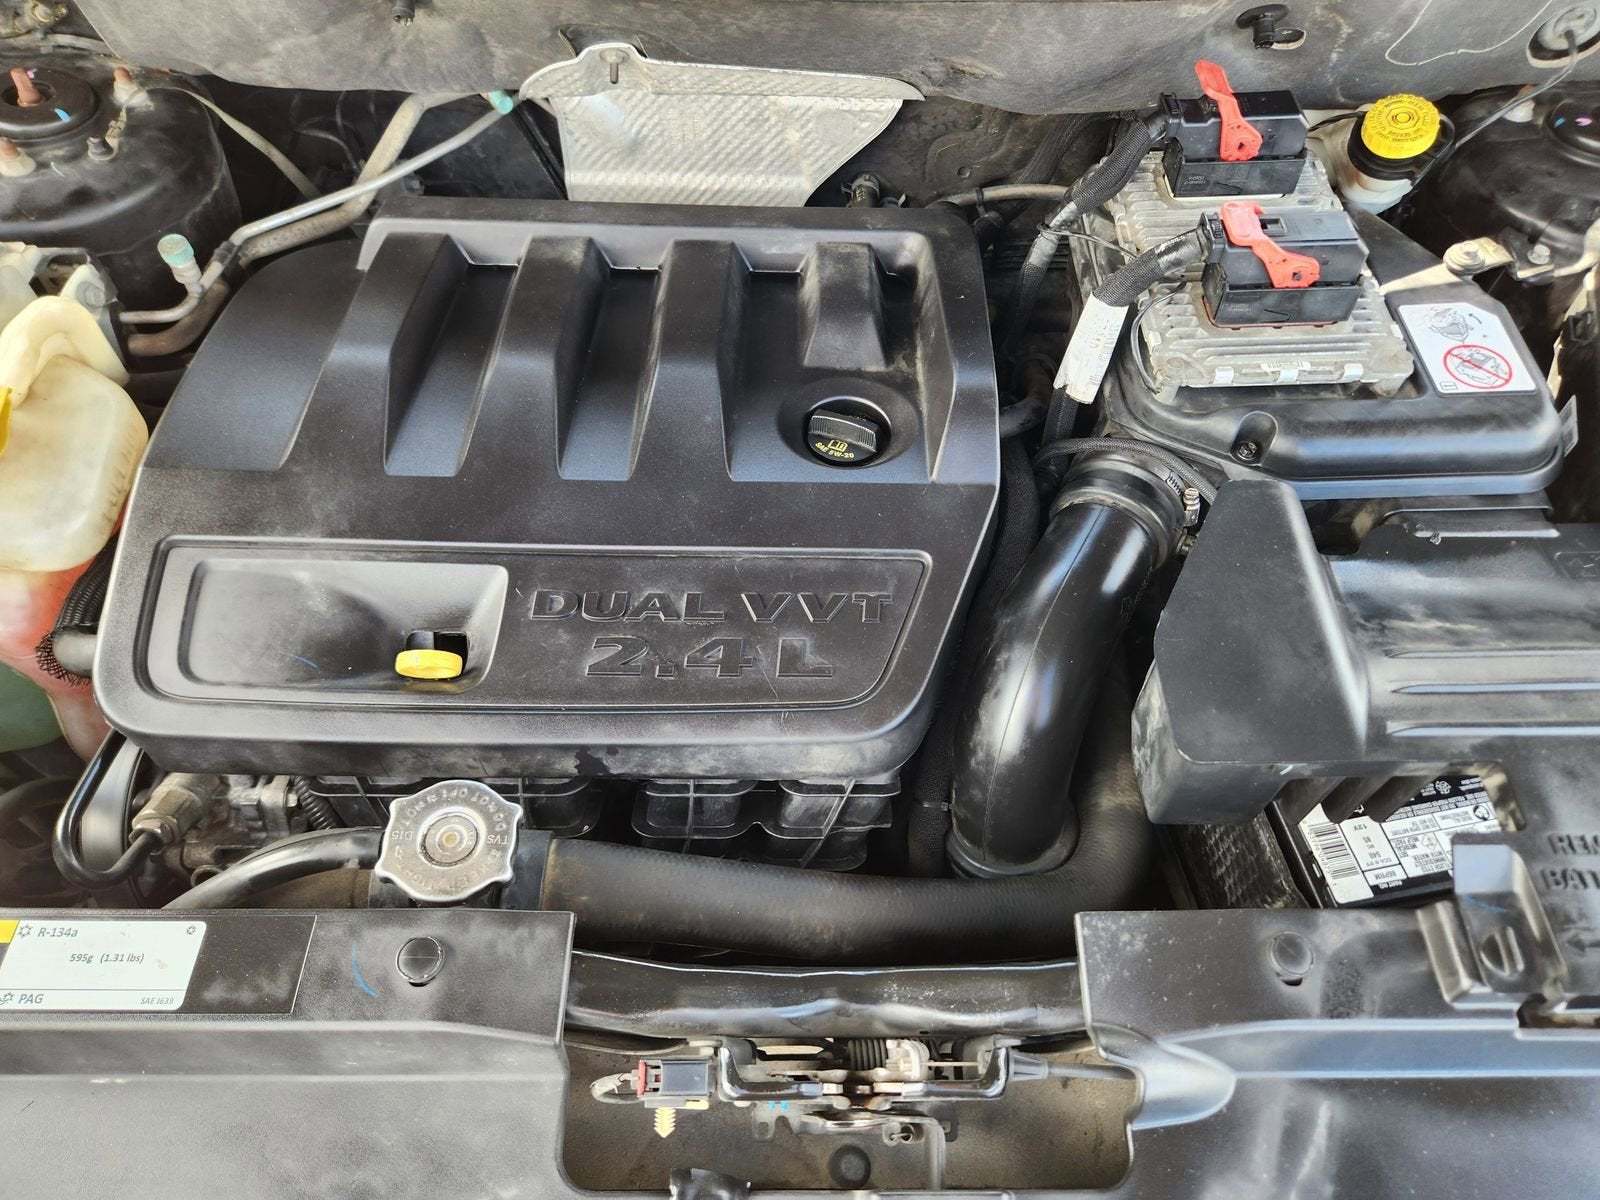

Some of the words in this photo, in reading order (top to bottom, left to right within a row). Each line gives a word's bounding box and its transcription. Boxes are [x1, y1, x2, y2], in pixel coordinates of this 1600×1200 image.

[815, 442, 830, 453] SAE
[828, 449, 855, 459] 5W-20
[530, 590, 725, 622] DUAL
[740, 592, 894, 623] VVT
[1353, 823, 1368, 831] 12V
[487, 834, 510, 845] TVS
[37, 927, 79, 938] R-134a
[69, 953, 93, 964] 595g
[100, 953, 125, 964] (1.31
[126, 953, 145, 964] lbs)
[18, 994, 44, 1005] PAG
[140, 997, 156, 1005] SAE
[156, 997, 174, 1005] J639
